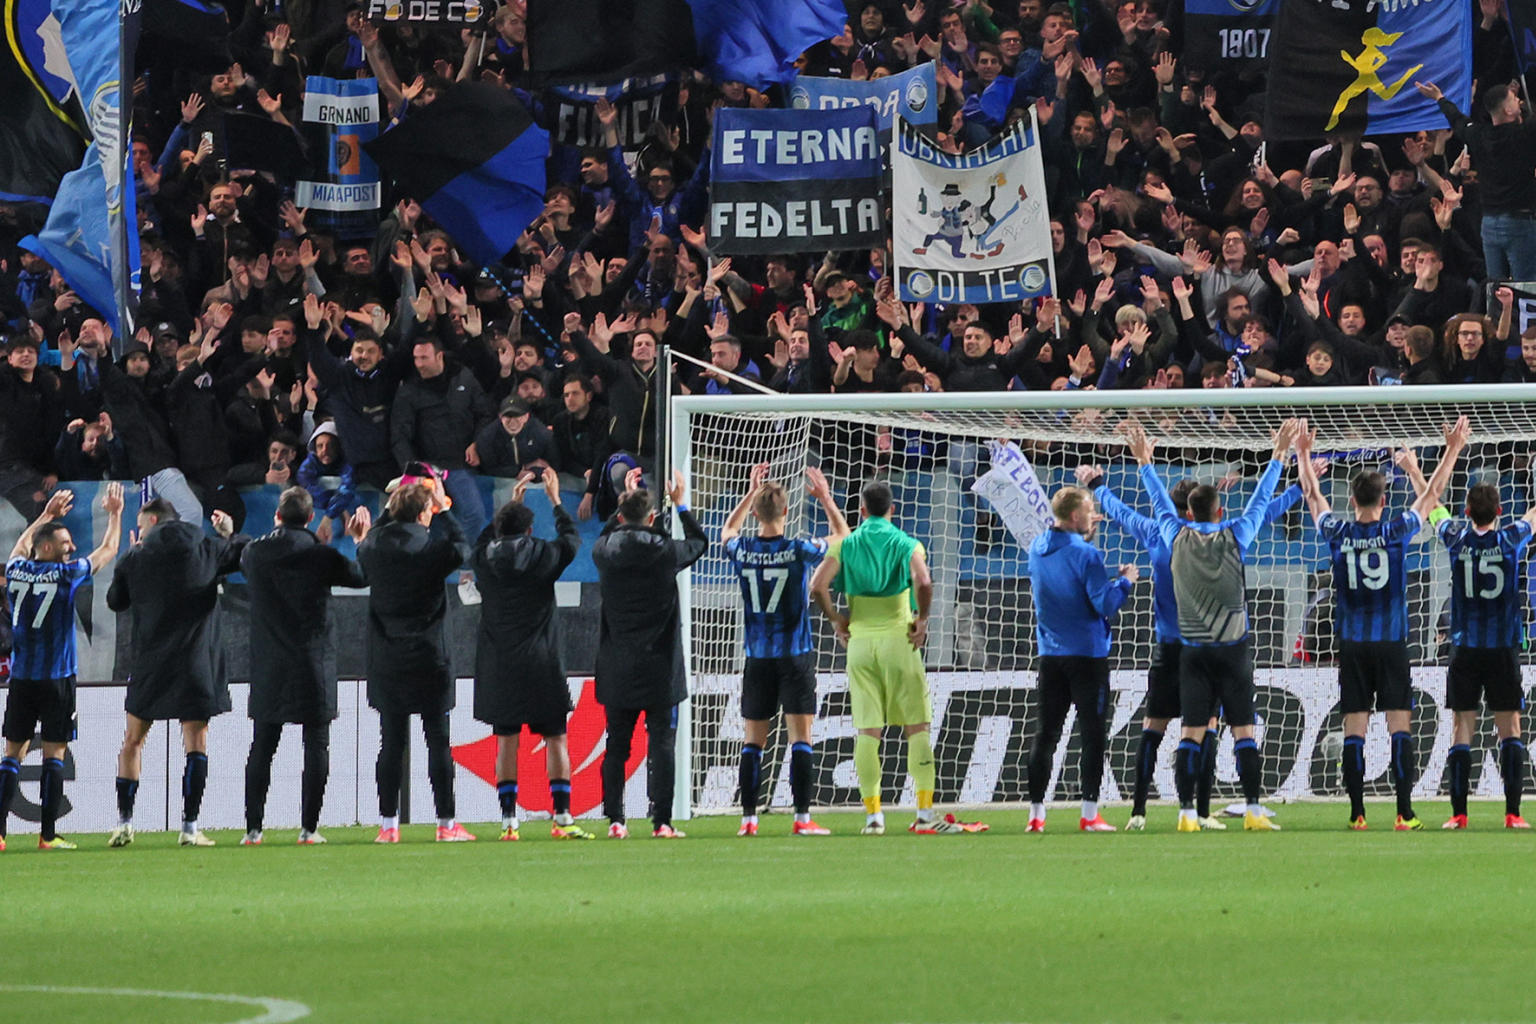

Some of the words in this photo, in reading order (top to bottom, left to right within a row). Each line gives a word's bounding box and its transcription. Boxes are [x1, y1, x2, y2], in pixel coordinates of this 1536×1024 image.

[408, 0, 442, 21] DE
[1218, 28, 1271, 59] 1907
[721, 126, 878, 165] ETERNA
[937, 271, 966, 302] DI
[978, 267, 1019, 301] TE
[1340, 547, 1390, 591] 19
[1458, 554, 1506, 600] 15
[8, 580, 59, 629] 77
[741, 568, 790, 613] 17
